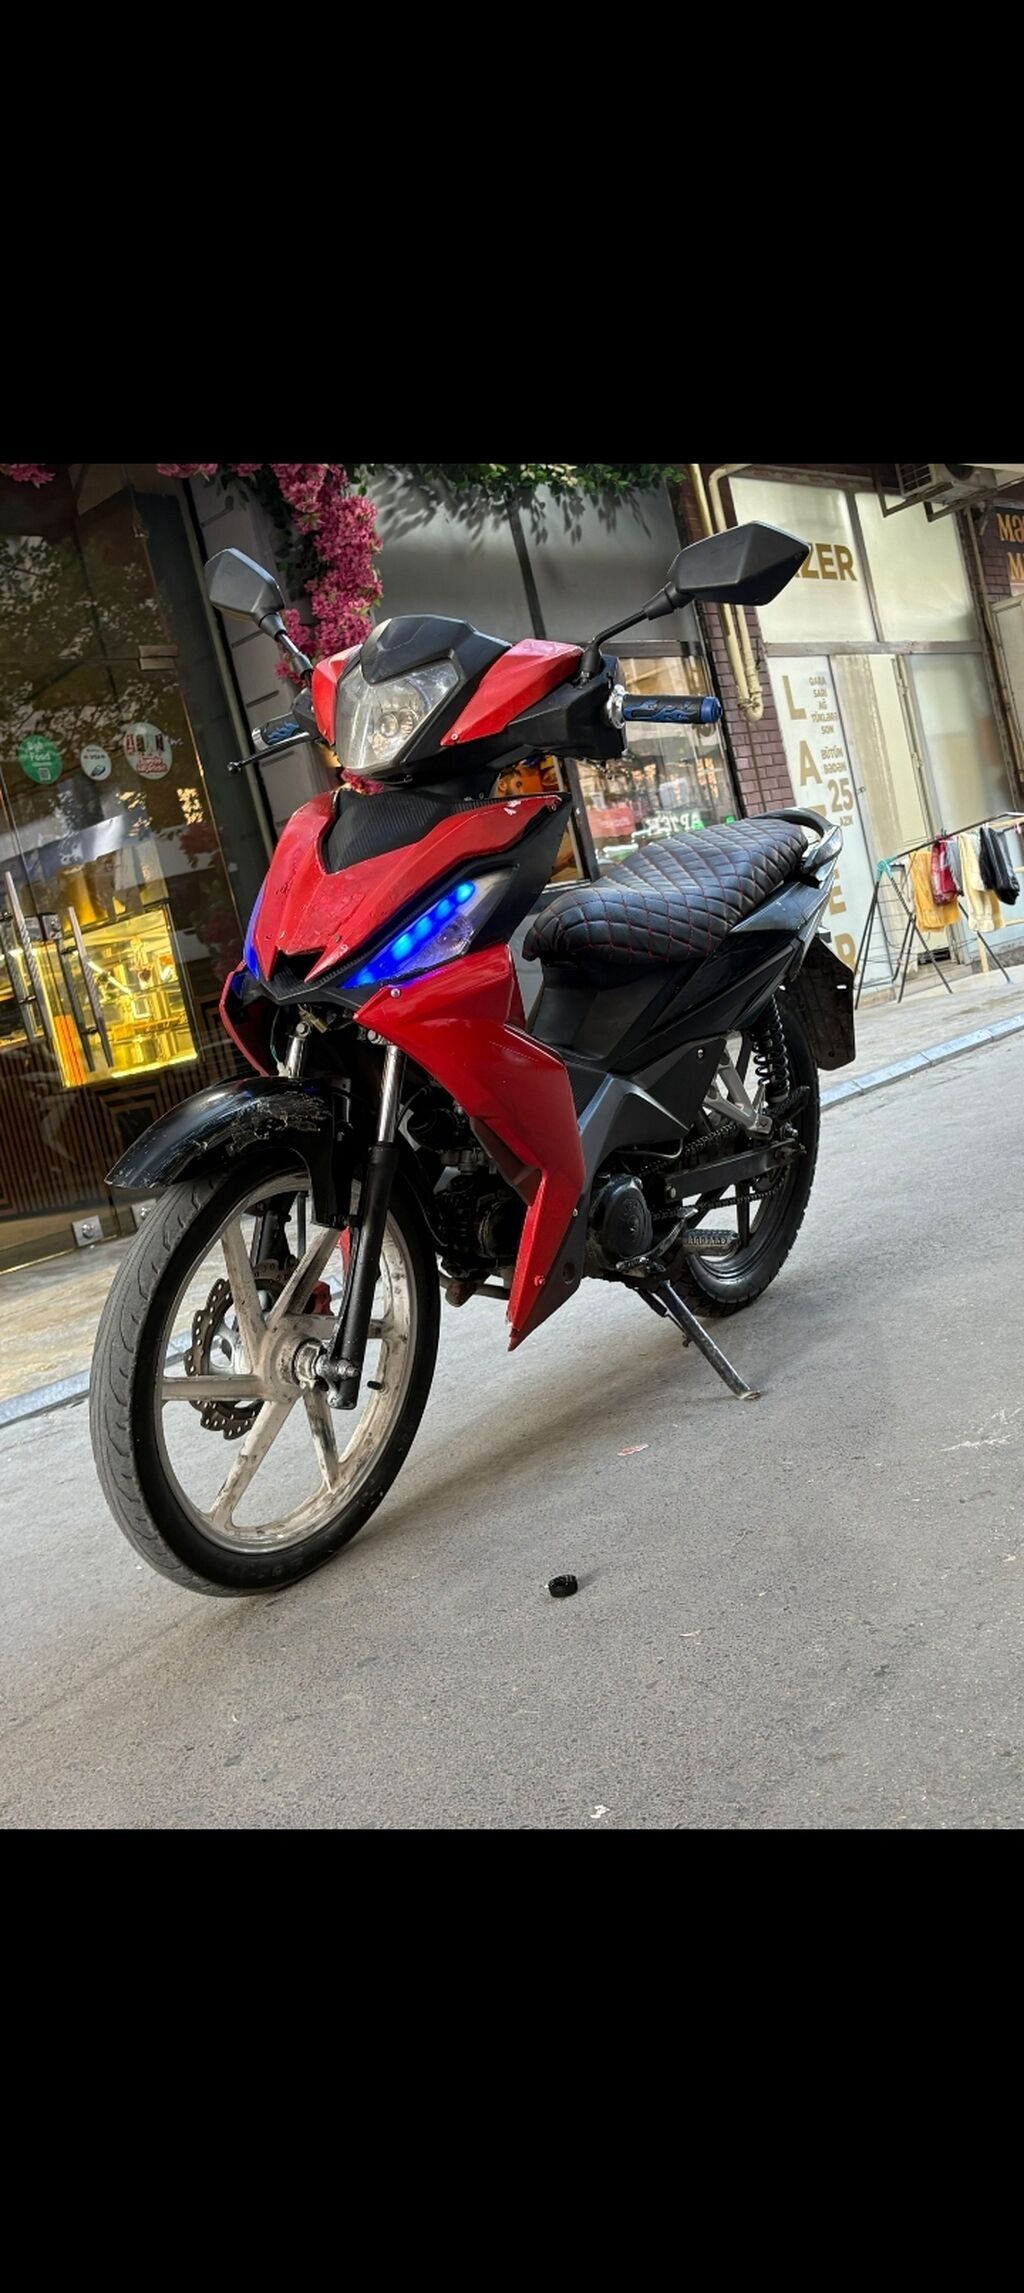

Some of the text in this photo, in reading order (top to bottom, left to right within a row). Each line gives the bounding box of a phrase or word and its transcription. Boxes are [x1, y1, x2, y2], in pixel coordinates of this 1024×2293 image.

[997, 513, 1024, 544] Ma
[796, 543, 858, 581] ZER
[820, 725, 834, 735] SON
[29, 751, 52, 761] Food
[827, 777, 854, 813] 25
